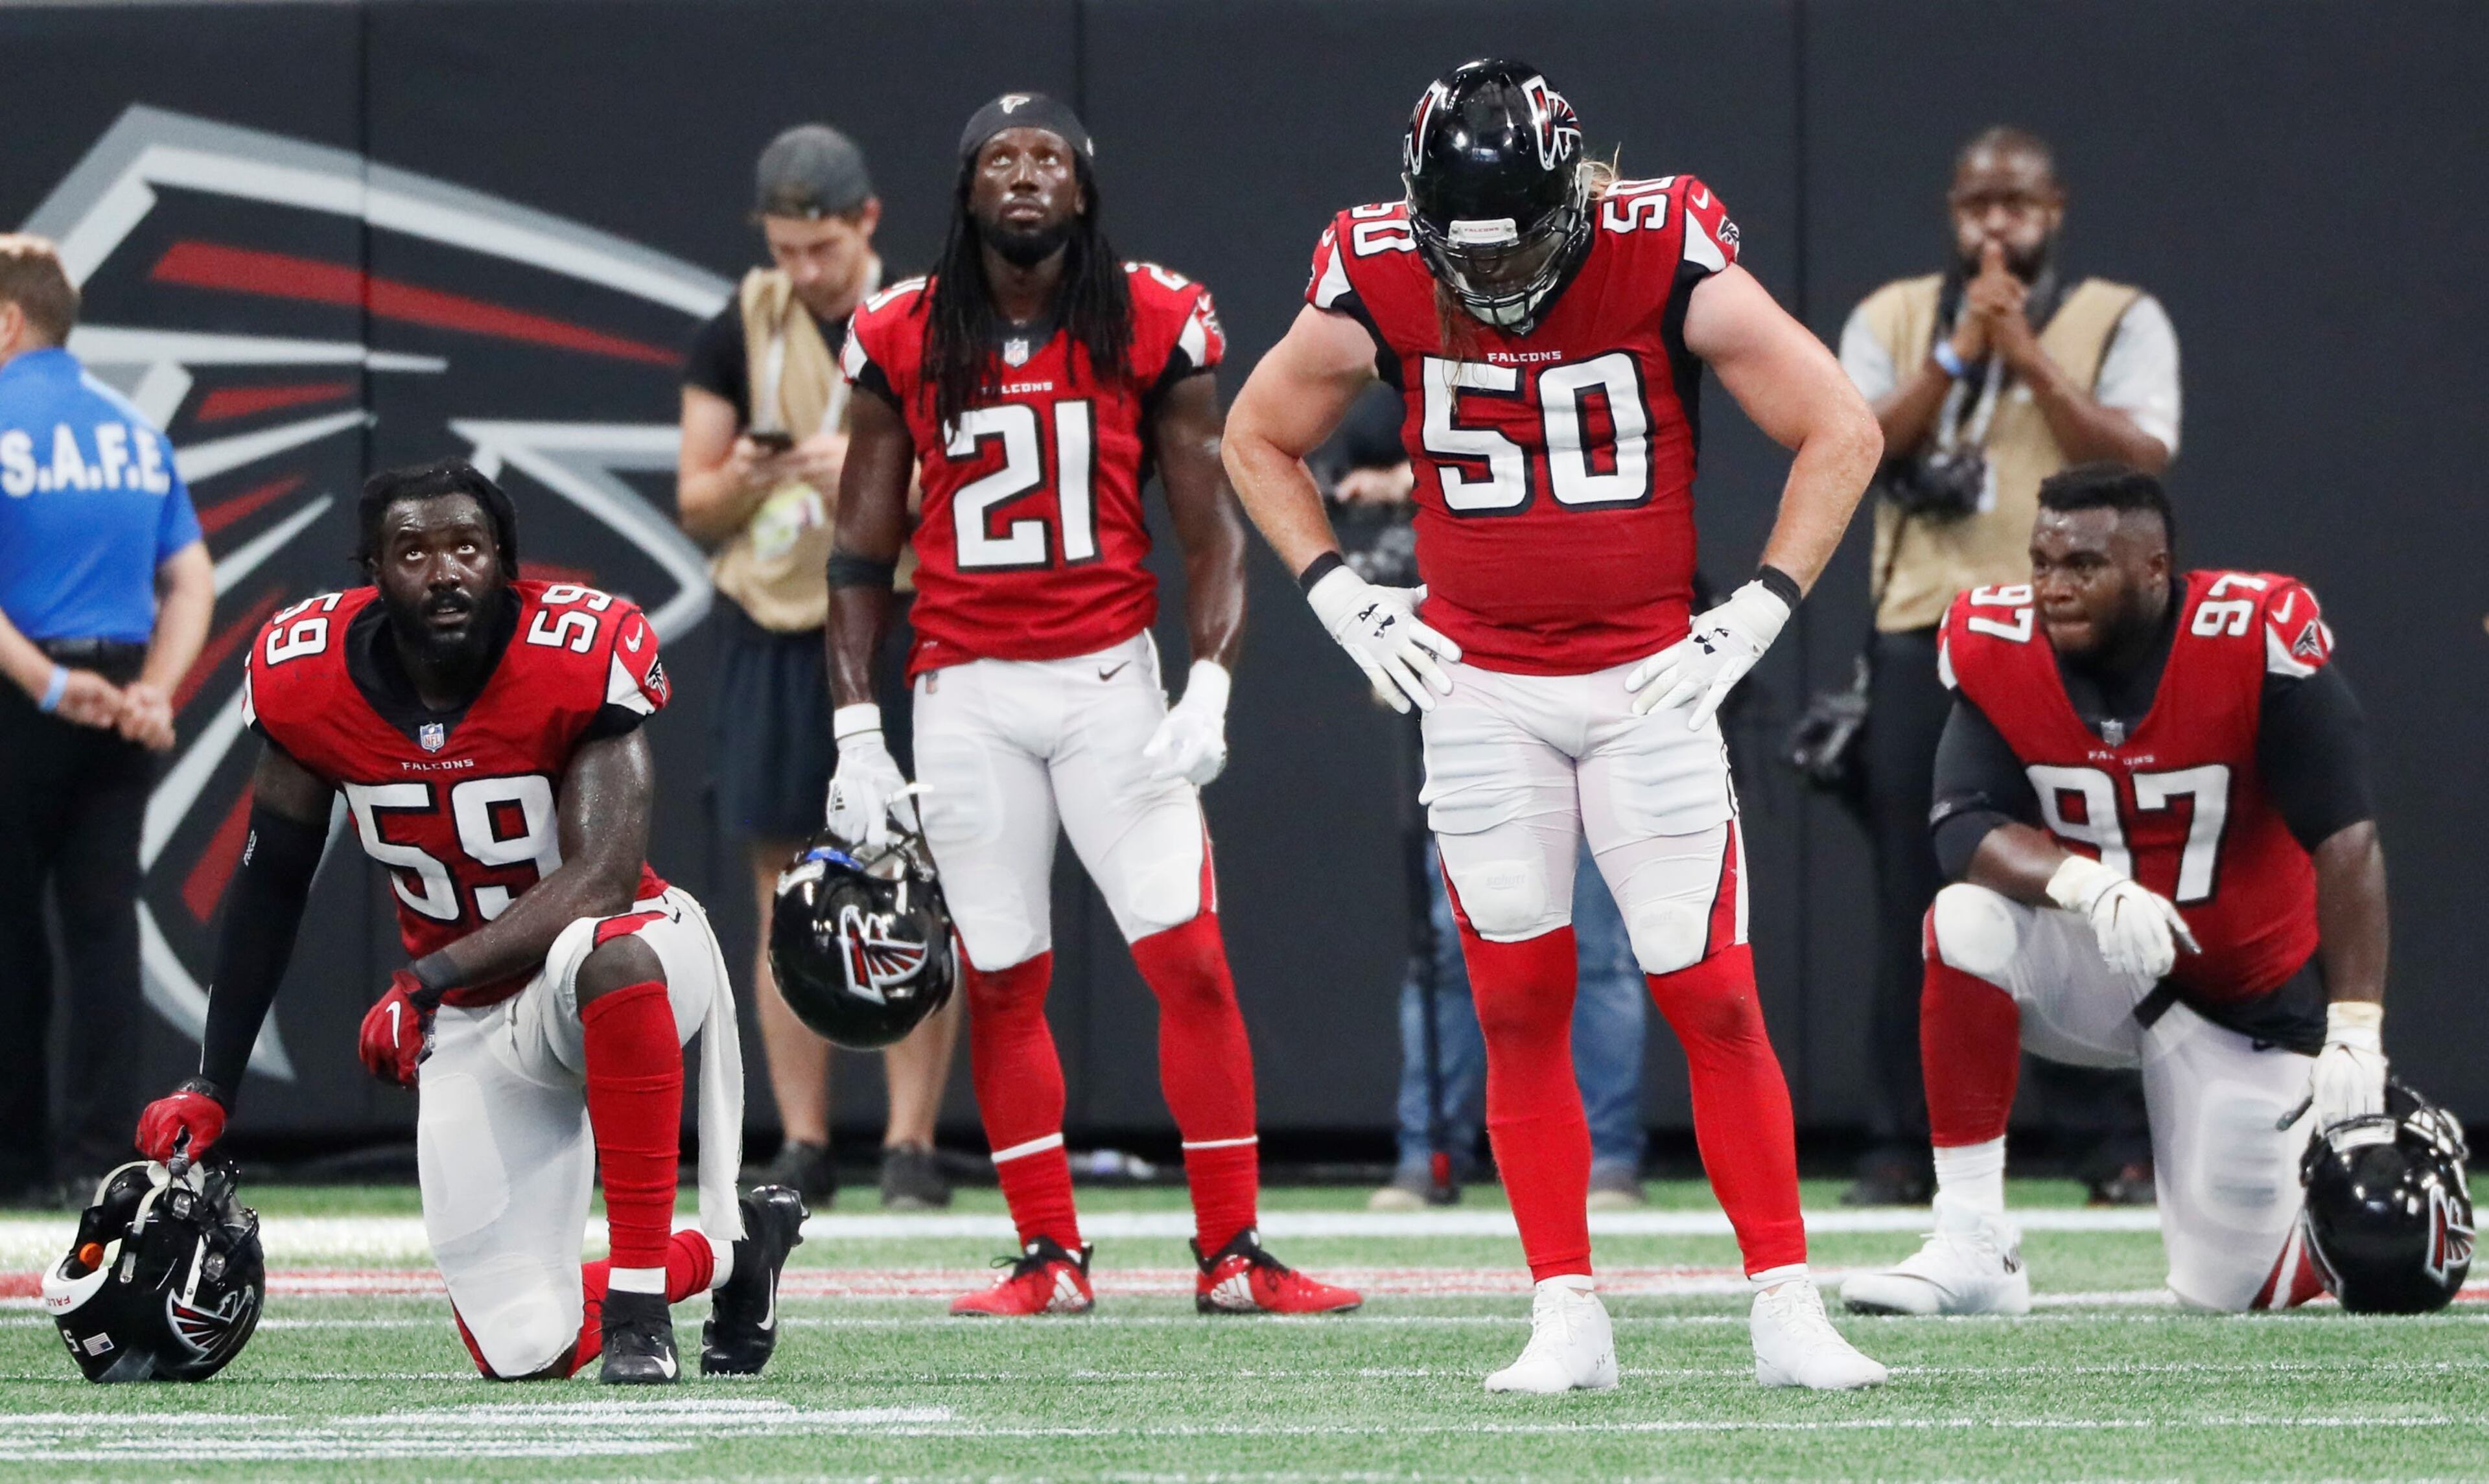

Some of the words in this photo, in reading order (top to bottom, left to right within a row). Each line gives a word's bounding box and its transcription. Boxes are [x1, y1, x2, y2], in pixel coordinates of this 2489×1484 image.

[1351, 200, 1418, 257] 50
[1603, 176, 1676, 234] 50
[1487, 351, 1562, 363] FALCONS
[980, 381, 1053, 395] LCONS
[1422, 352, 1648, 511] 50
[943, 400, 1095, 568] 21
[265, 592, 345, 666] 59
[526, 585, 614, 654] 59
[1968, 584, 2034, 642] 97
[2191, 572, 2268, 636] 97
[401, 758, 474, 771] FALCONS
[425, 734, 441, 746] NFL
[342, 774, 563, 922] 59
[2025, 763, 2230, 902] 97
[45, 1295, 71, 1306] FALC
